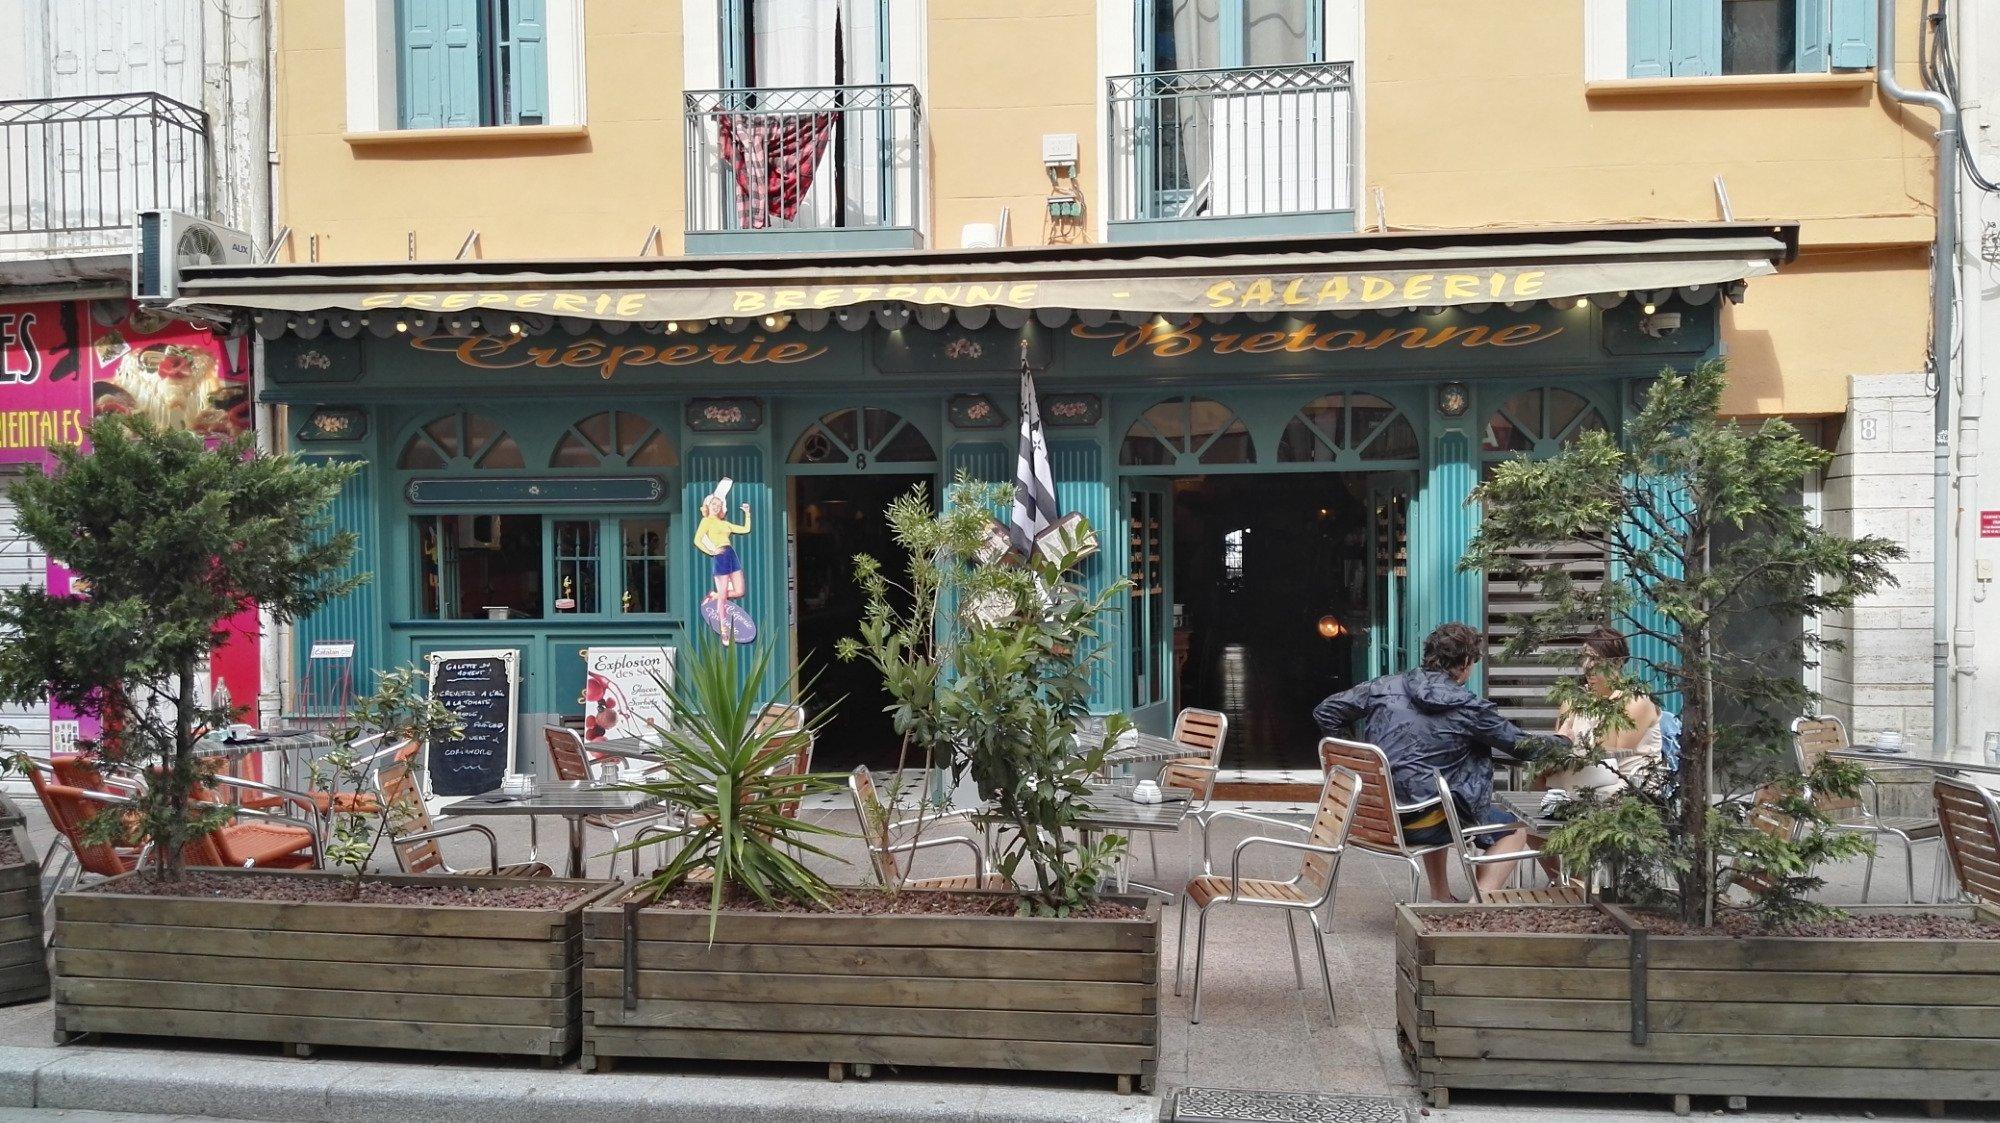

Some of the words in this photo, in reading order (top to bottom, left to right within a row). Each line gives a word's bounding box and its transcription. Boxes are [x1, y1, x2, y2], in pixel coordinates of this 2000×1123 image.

[232, 243, 248, 254] AUX
[362, 293, 647, 316] CREPERIE
[732, 284, 1039, 312] BRETONNE
[1205, 272, 1546, 308] SALADERIE
[1071, 316, 1564, 358] Bretonne
[410, 334, 829, 380] Crêperie
[0, 409, 83, 448] IENTALES
[1861, 420, 1876, 440] 8
[856, 453, 867, 470] 8
[446, 663, 478, 671] GALETTE
[594, 654, 660, 673] Explosion
[616, 668, 633, 678] des
